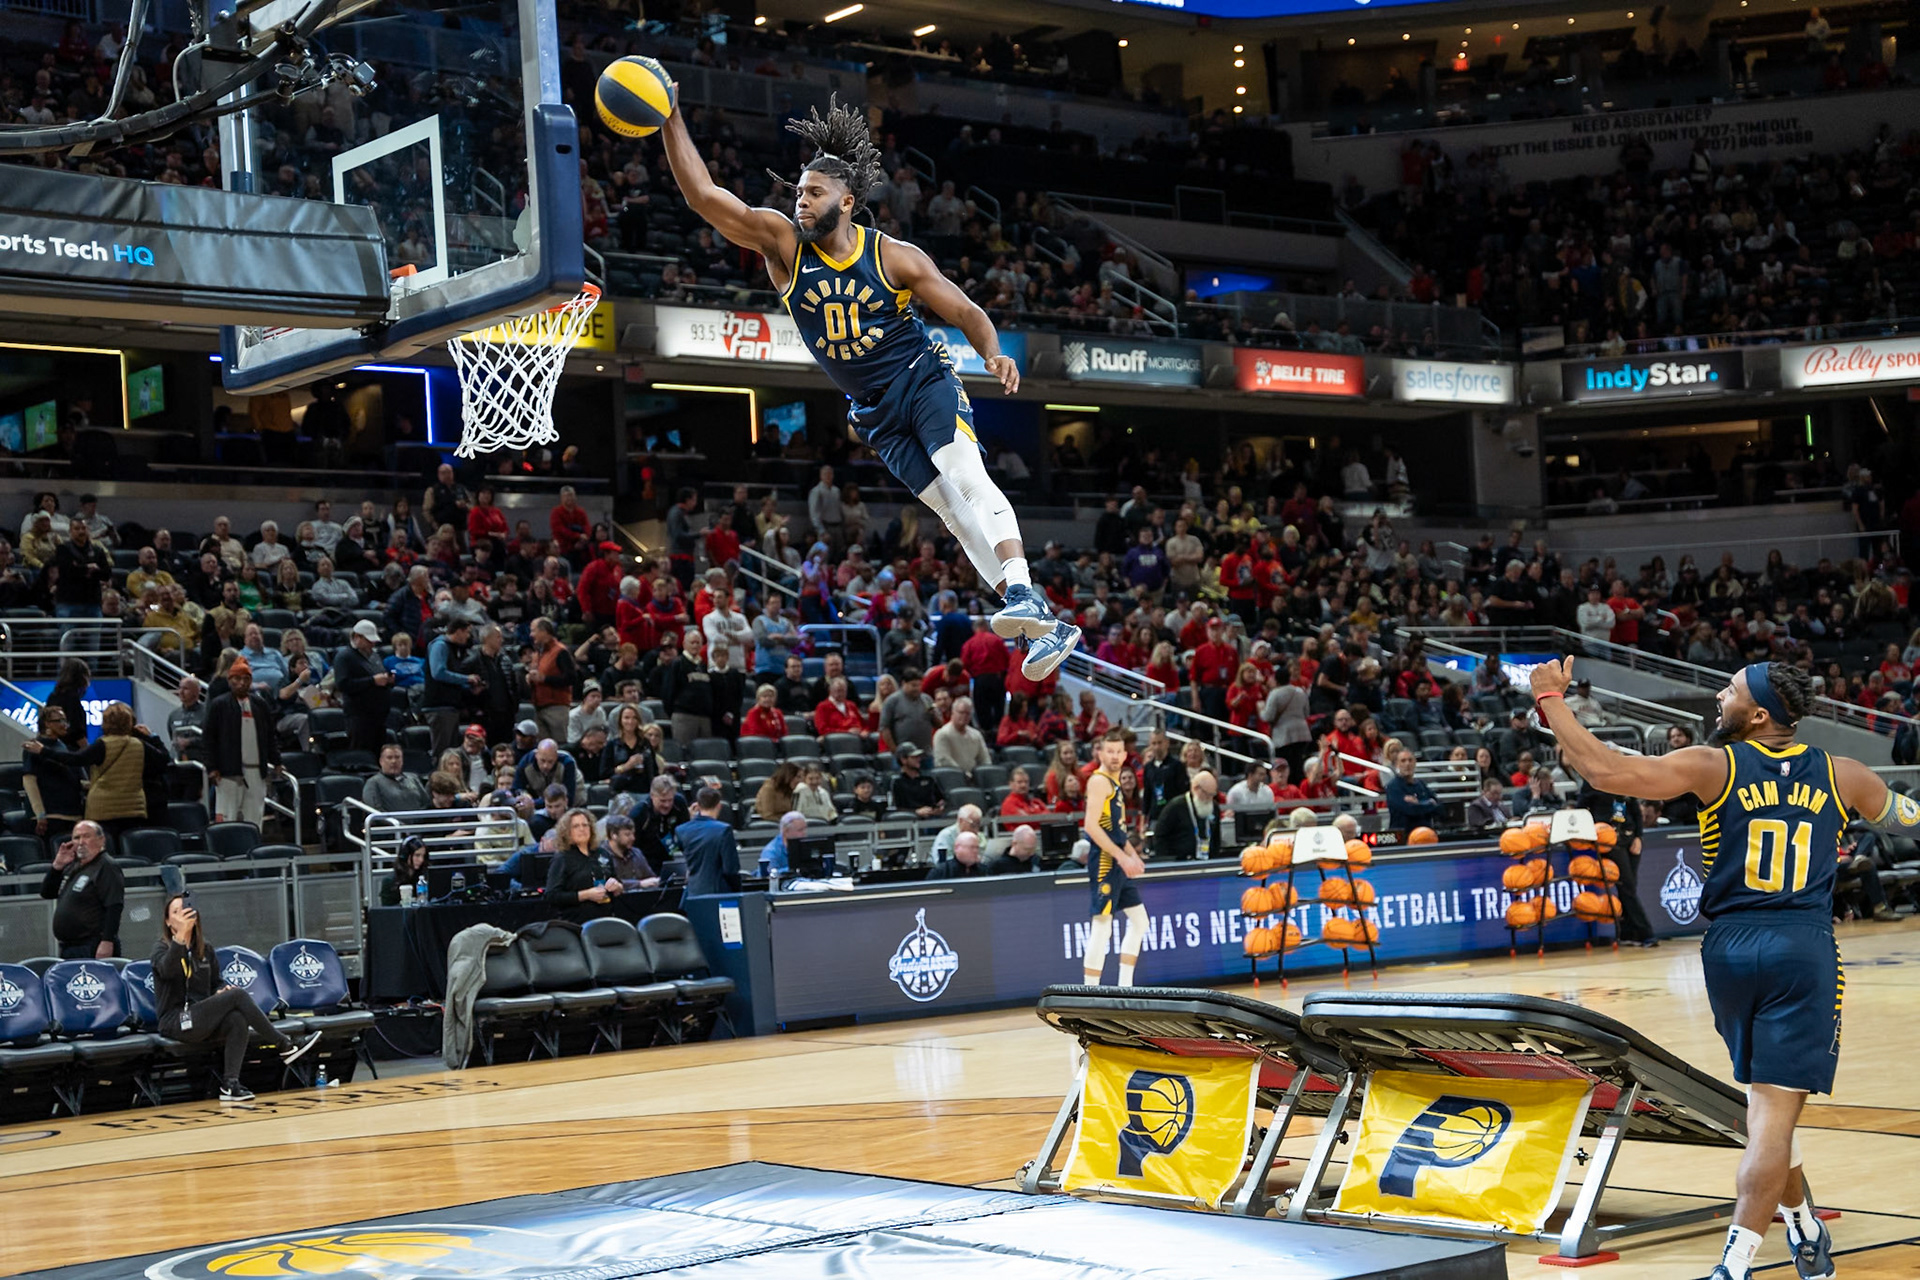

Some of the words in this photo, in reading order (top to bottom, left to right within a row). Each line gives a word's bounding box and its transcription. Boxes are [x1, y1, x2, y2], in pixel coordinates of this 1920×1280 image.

[1573, 118, 1609, 133] NEED
[1613, 109, 1712, 130] ASSISTANCE?
[1523, 140, 1550, 155] THE
[1552, 136, 1595, 151] ISSUE
[1611, 127, 1678, 146] LOATION
[1682, 126, 1699, 140] TO
[49, 236, 108, 262] Tech
[113, 244, 155, 267] HQ
[800, 277, 884, 313] INDIANA
[495, 312, 605, 338] BRIDGE
[690, 322, 716, 342] 93.5
[719, 310, 761, 338] the
[823, 302, 862, 341] 01
[815, 326, 884, 361] PACERS
[1091, 347, 1148, 373] Ruoff
[1148, 356, 1201, 371] MORTGAGE
[1271, 364, 1313, 382] BELLE
[1315, 367, 1346, 384] TIRE
[1804, 344, 1885, 377] Bally
[1405, 365, 1501, 398] salesforce
[1737, 780, 1780, 812] CAM
[1787, 781, 1829, 815] JAM
[1744, 818, 1813, 893] 01
[1063, 912, 1201, 960] ININA'S
[1210, 904, 1312, 946] NET
[1471, 879, 1587, 922] TRAIO
